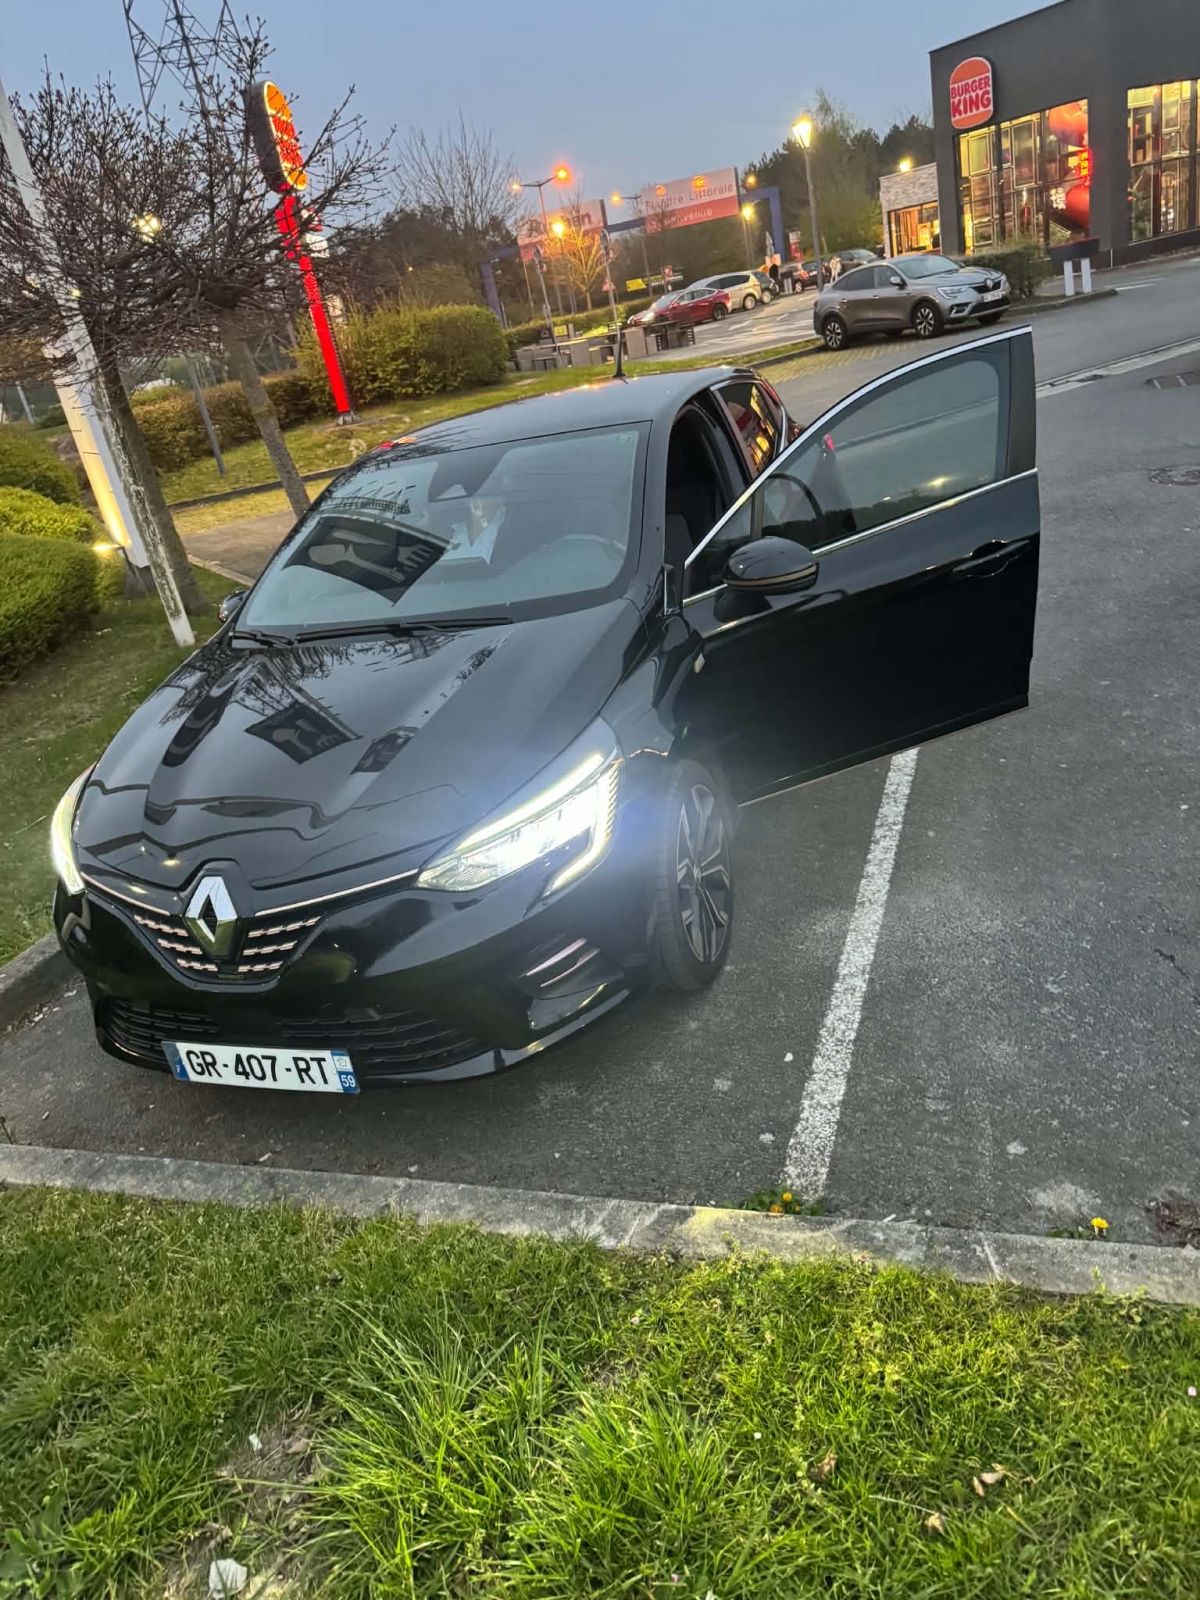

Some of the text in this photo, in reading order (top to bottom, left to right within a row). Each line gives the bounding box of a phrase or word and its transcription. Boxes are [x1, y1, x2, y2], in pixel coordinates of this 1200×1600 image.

[951, 75, 991, 99] BURGER
[951, 90, 992, 119] KING
[185, 1050, 329, 1085] GR-407-RT
[340, 1074, 356, 1087] 59
